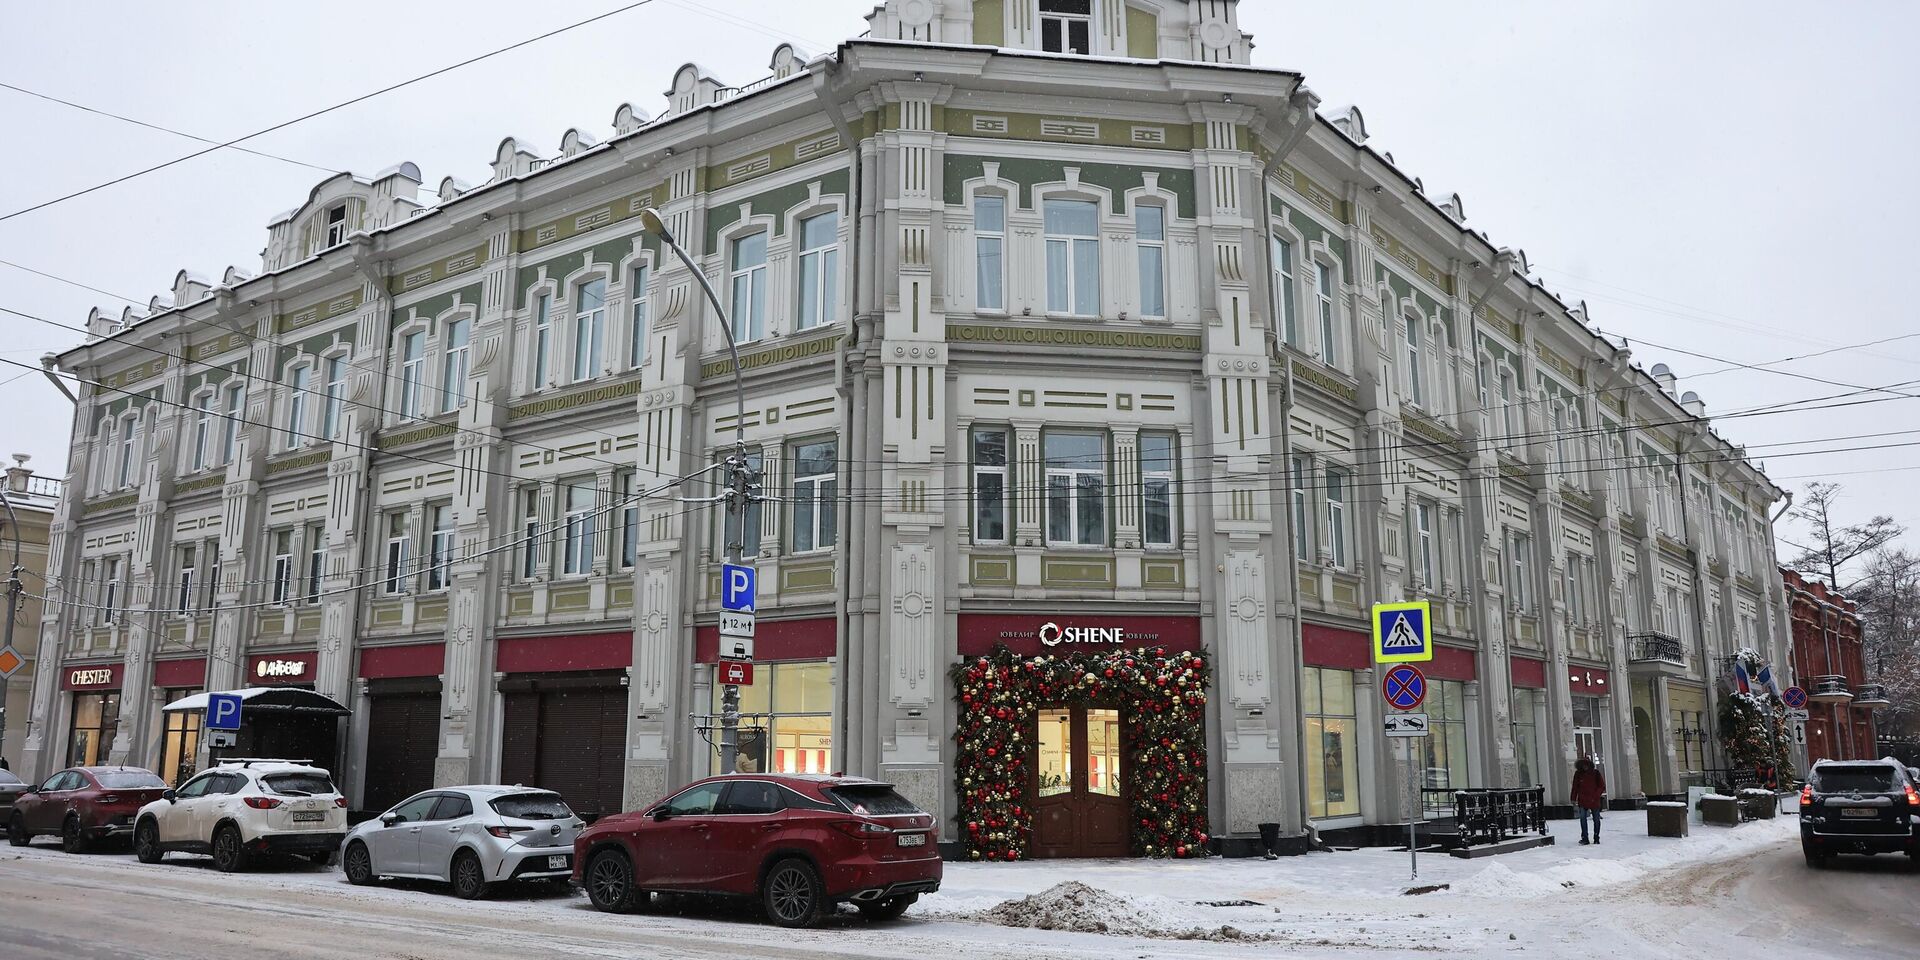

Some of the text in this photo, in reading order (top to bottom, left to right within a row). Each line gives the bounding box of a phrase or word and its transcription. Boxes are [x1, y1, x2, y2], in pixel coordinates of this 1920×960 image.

[731, 569, 749, 603] P
[730, 619, 738, 628] 12
[1065, 627, 1124, 643] SHENE
[1126, 632, 1158, 640] ЮВЕЛИР
[71, 669, 111, 685] CHESTER
[216, 699, 236, 724] P
